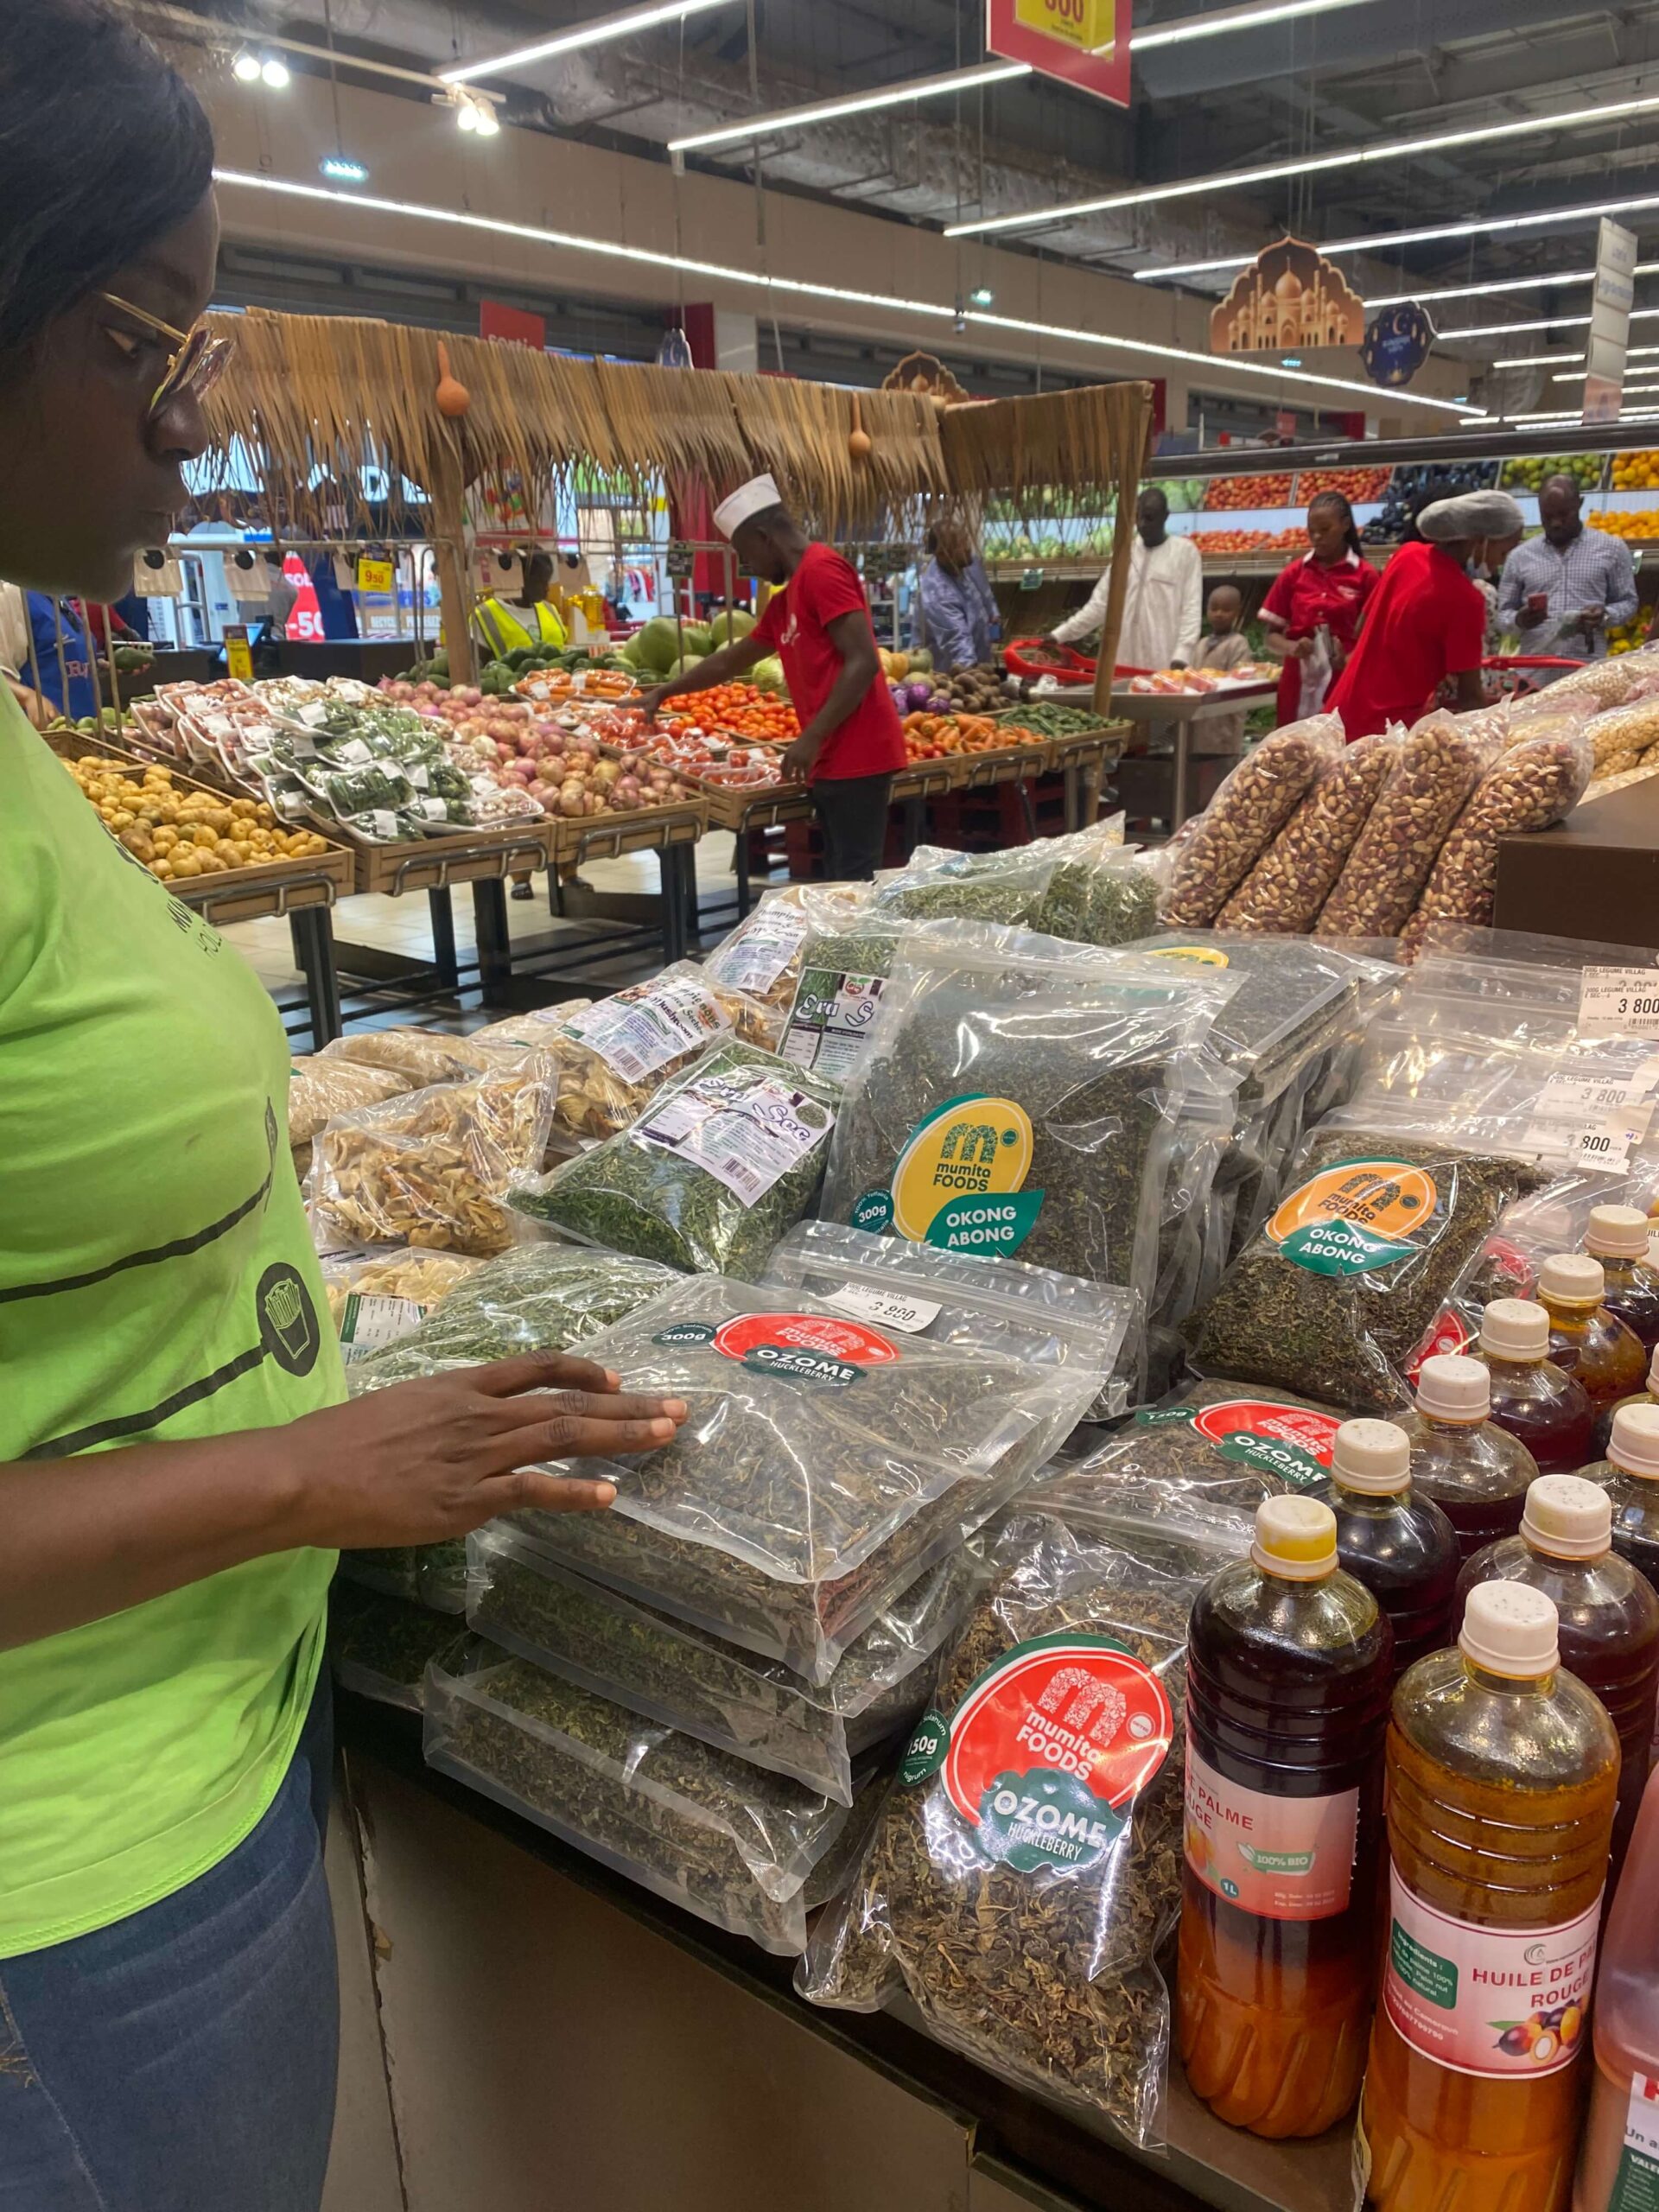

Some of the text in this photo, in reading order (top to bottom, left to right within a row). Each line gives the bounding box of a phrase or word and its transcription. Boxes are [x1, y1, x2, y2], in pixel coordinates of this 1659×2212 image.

[795, 993, 840, 1020] Eru
[1618, 998, 1659, 1014] 3 800
[694, 1077, 751, 1103] Eru
[1580, 1088, 1626, 1103] 3 800
[752, 1103, 810, 1141] Sec
[1582, 1135, 1611, 1152] 800
[932, 1173, 988, 1192] FOODS
[936, 1162, 991, 1179] mumita
[858, 1205, 887, 1224] 300g
[946, 1205, 1017, 1228] OKONG
[1327, 1192, 1376, 1220] mumita
[947, 1225, 1015, 1248] ABONG
[1309, 1228, 1378, 1253] OKONG
[1299, 1241, 1366, 1264] ABONG
[887, 1292, 907, 1302] VILLAG
[661, 1332, 706, 1341] 300g
[774, 1330, 843, 1358] FOODS
[757, 1349, 855, 1381] OZOME
[770, 1359, 836, 1382] HUCKLEBERRY
[1147, 1411, 1188, 1420] 150g
[1256, 1421, 1320, 1457] FOODS
[1244, 1447, 1307, 1483] HUCKLEBERRY
[1026, 1712, 1102, 1763] mumita
[1016, 1726, 1093, 1782] FOODS
[994, 1789, 1107, 1848] OZOME
[1198, 1785, 1253, 1832] PALME
[1007, 1822, 1083, 1861] HUCKLEBERRY
[1256, 1854, 1309, 1866] 100% BIO
[1472, 1961, 1573, 1986] HUILE DE
[1531, 1968, 1589, 2008] ROUGE
[1626, 2126, 1659, 2150] Un a
